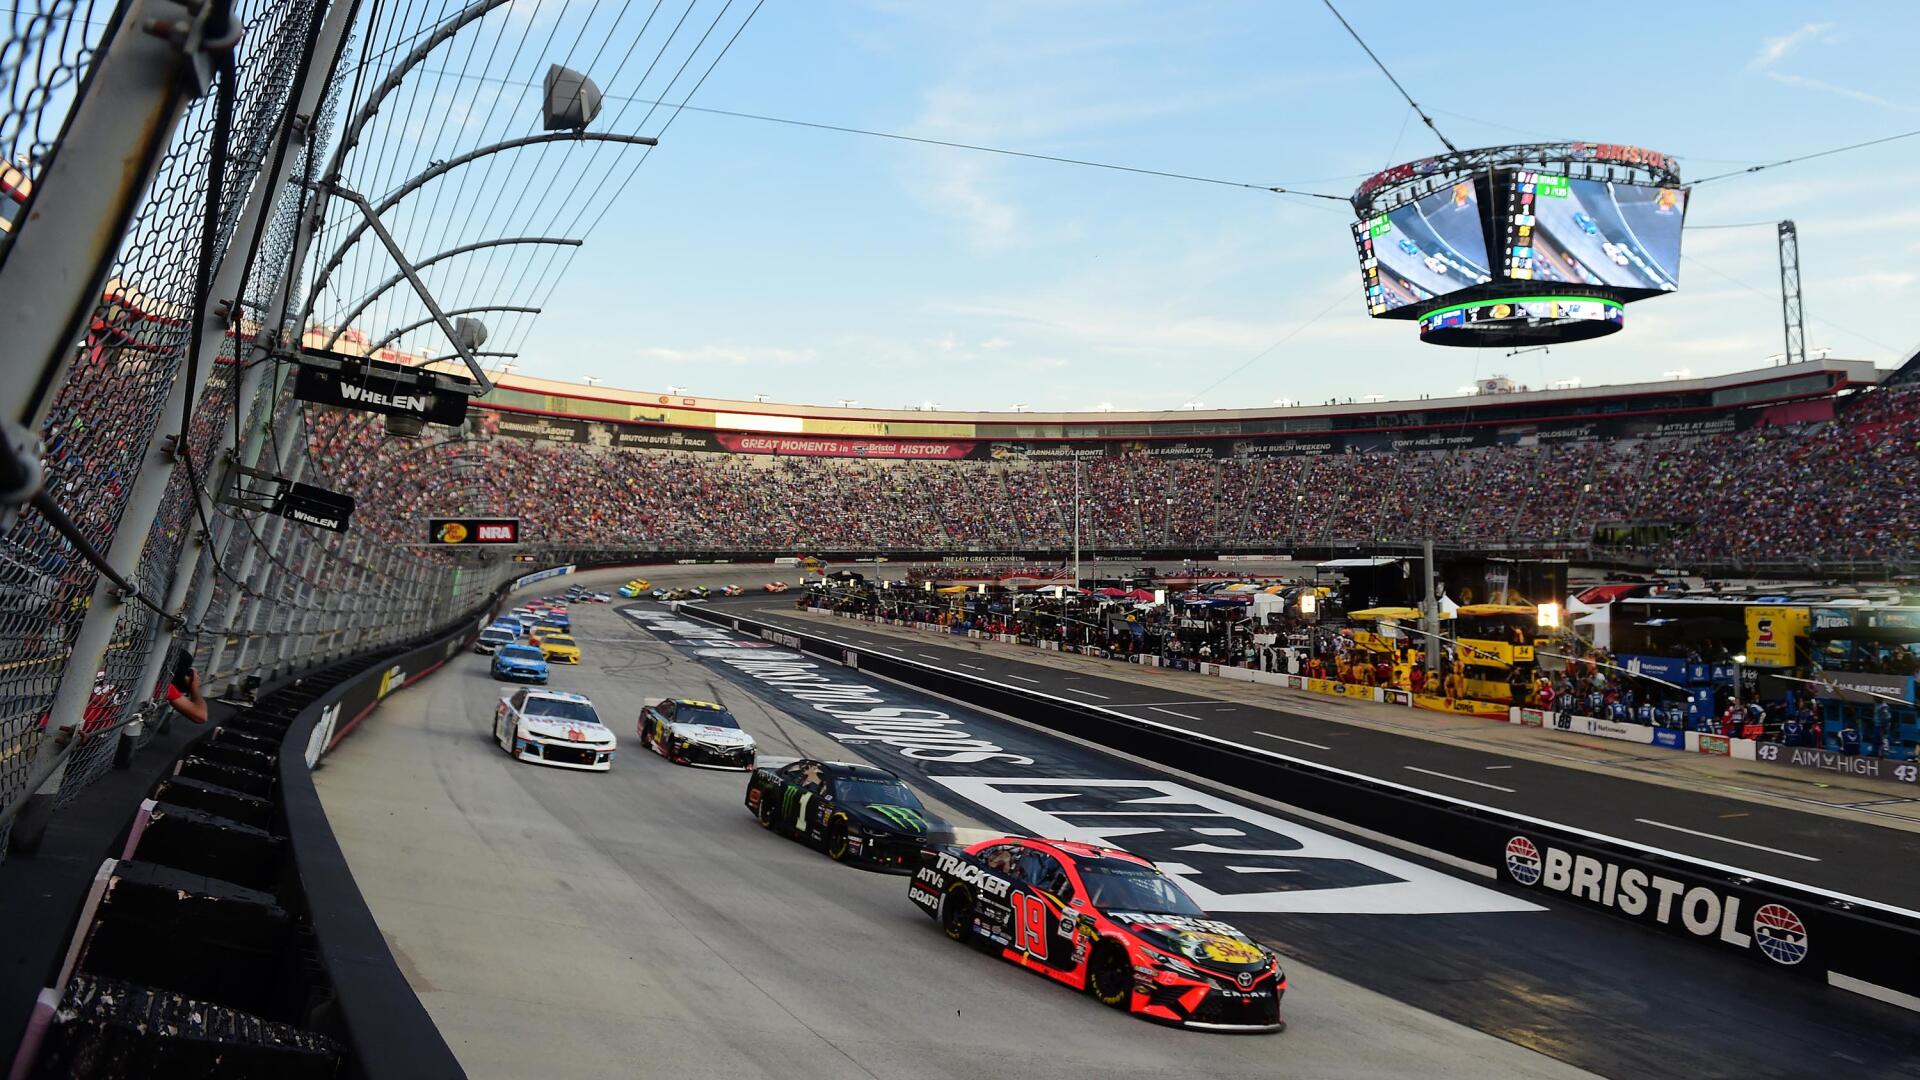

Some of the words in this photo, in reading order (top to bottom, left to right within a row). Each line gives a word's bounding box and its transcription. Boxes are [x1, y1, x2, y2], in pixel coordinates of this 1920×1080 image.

[1594, 143, 1666, 170] BRISTOL
[340, 381, 426, 412] WHELEN
[1536, 430, 1577, 439] COLOSSUS
[1657, 423, 1689, 432] BATTLE
[1691, 422, 1704, 430] AT
[1705, 420, 1736, 429] BRISTOL
[619, 433, 648, 443] BRUTON
[649, 436, 668, 444] BUYS
[684, 438, 706, 446] TRACK
[741, 438, 778, 449] GREAT
[780, 440, 837, 452] MOMENTS
[868, 443, 896, 452] Bristol
[899, 445, 949, 454] HISTORY
[1295, 443, 1331, 451] WEEKEND
[1414, 438, 1445, 446] HELMET
[1446, 436, 1474, 444] THROW
[294, 509, 338, 529] WHELEN
[480, 526, 511, 539] NRA
[1871, 686, 1901, 694] FORCE
[813, 704, 1034, 764] Shops
[1759, 745, 1778, 760] 43
[1792, 749, 1821, 768] AIM
[1838, 758, 1879, 776] HIGH
[1894, 765, 1918, 782] 43
[796, 791, 814, 832] 1
[984, 783, 1411, 895] NRA
[917, 867, 944, 888] ATVs
[936, 852, 1011, 898] TRACKER
[909, 887, 939, 909] BOATS
[1543, 847, 1751, 949] BRISTOL
[1010, 889, 1048, 960] 19
